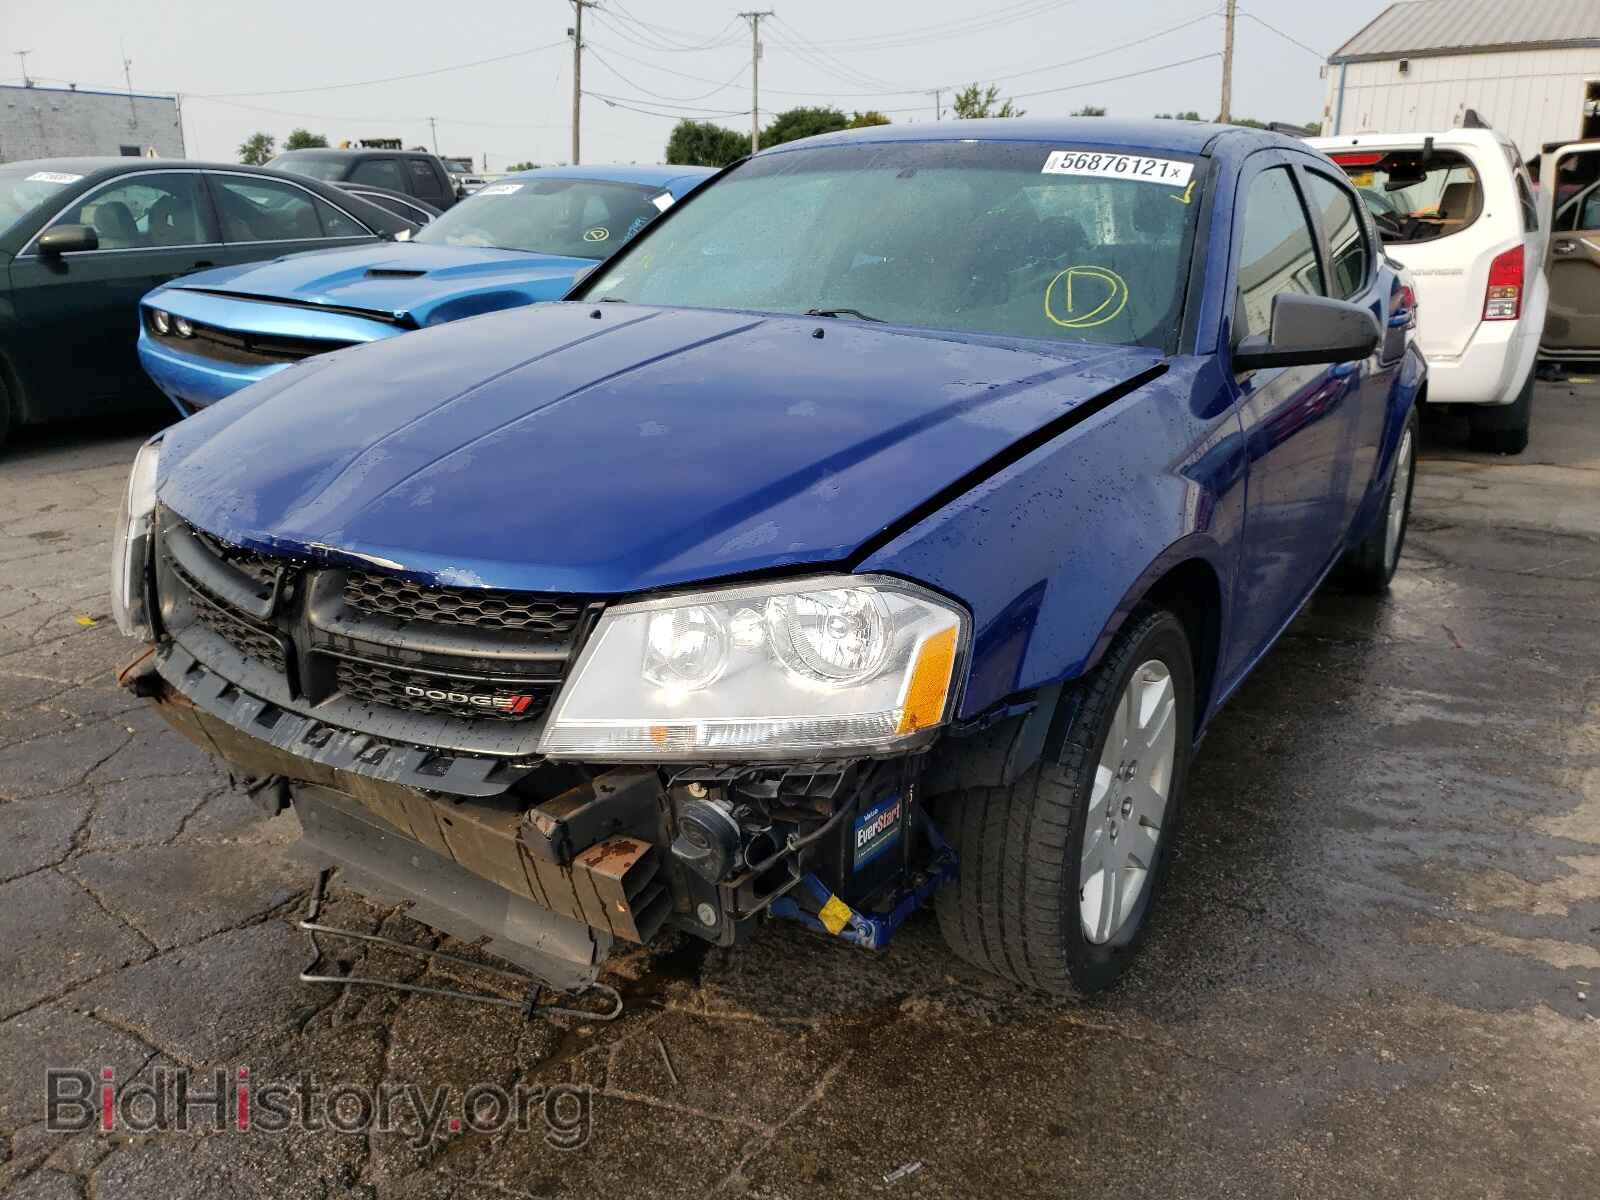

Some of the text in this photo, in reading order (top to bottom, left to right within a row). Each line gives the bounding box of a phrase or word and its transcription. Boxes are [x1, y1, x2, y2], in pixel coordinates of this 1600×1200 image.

[1059, 269, 1118, 325] D
[405, 686, 514, 708] DODGE
[857, 802, 900, 848] EverStart
